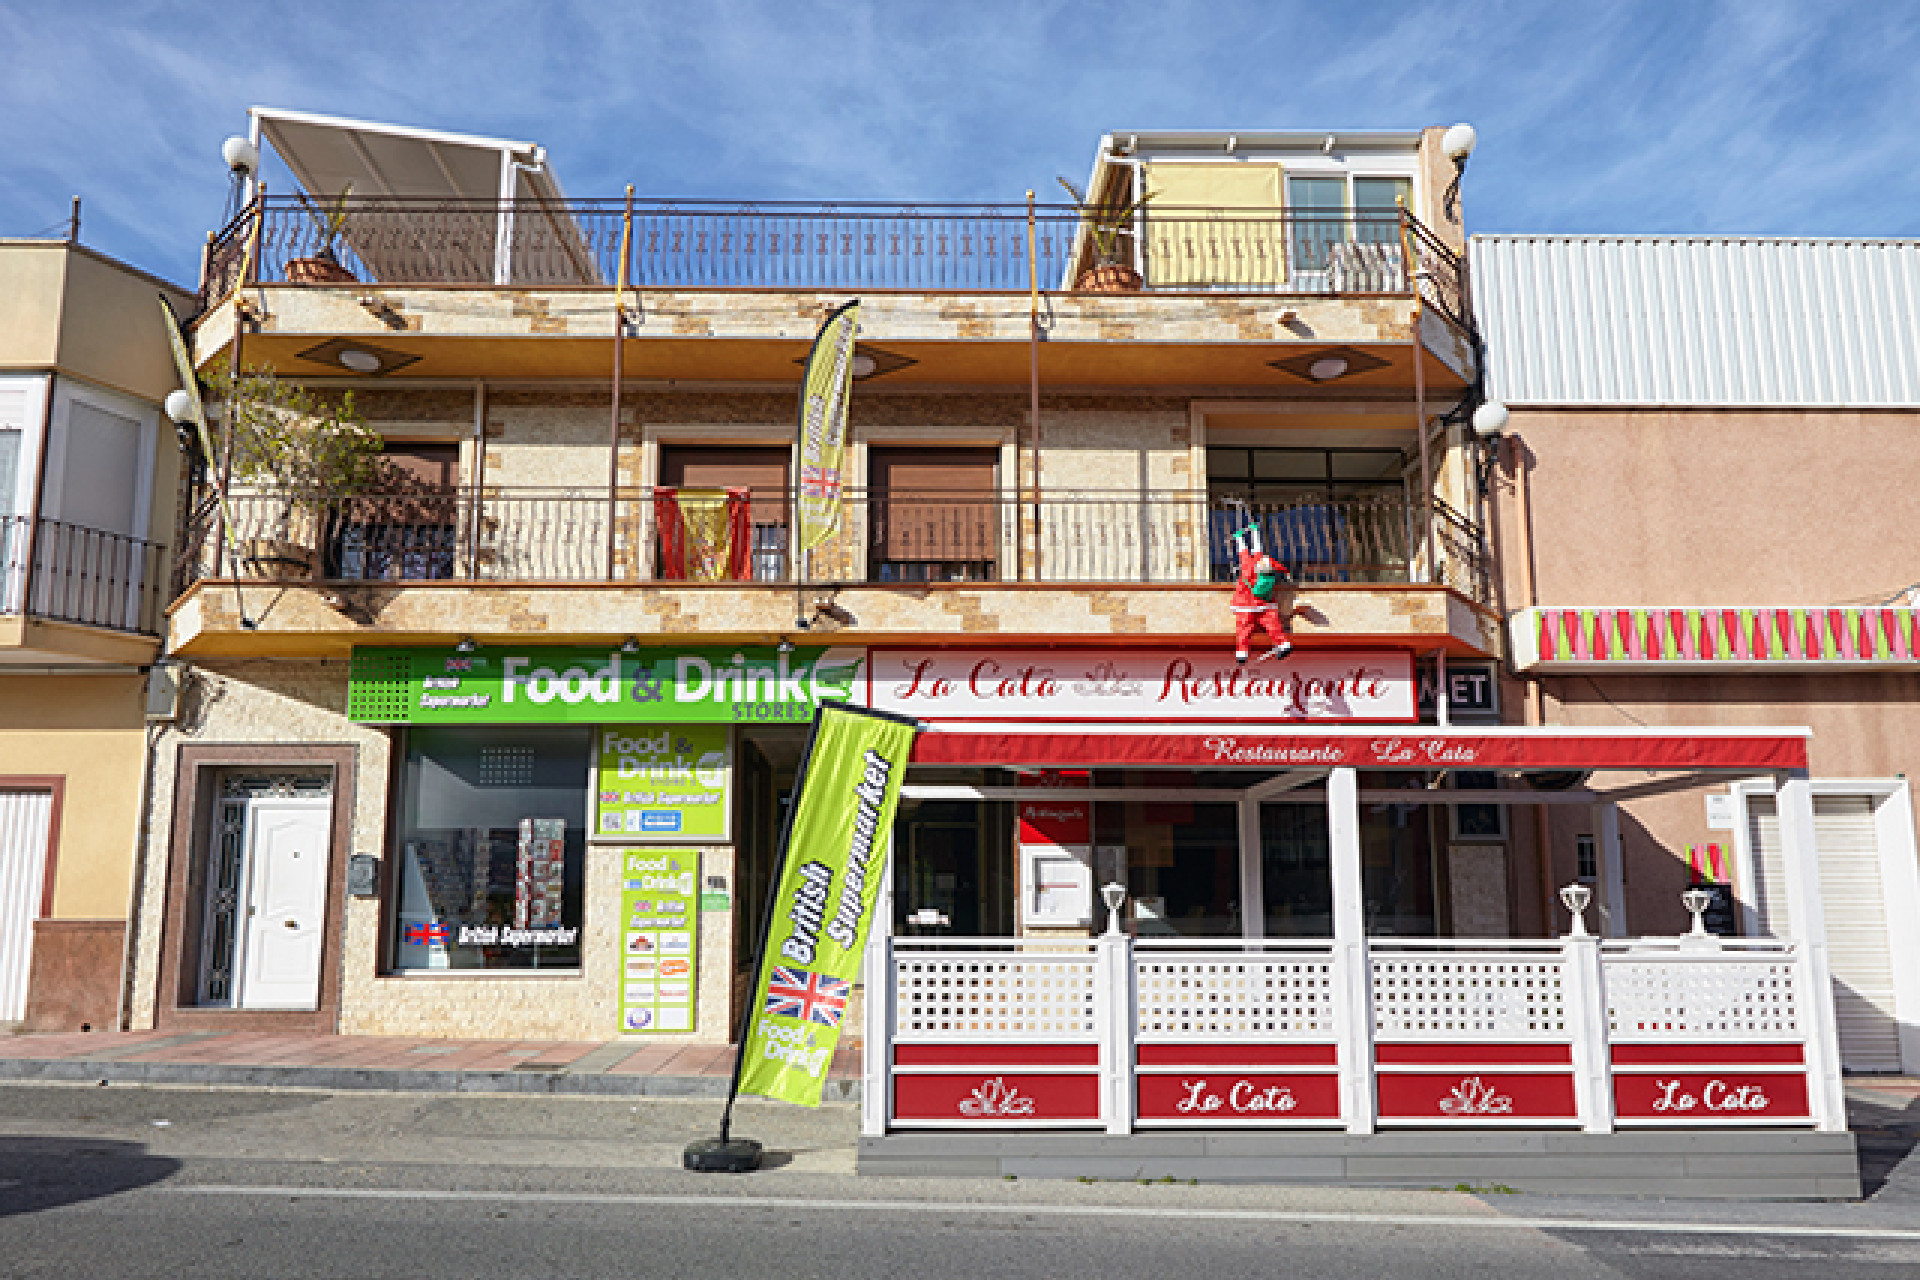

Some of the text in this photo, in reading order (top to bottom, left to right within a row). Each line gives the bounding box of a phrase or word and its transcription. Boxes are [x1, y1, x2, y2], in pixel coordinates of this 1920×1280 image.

[502, 653, 811, 704] Food & Drink
[893, 657, 1393, 704] La Cata Restaurante
[732, 702, 812, 720] STORES
[602, 730, 694, 755] Food &
[1203, 736, 1346, 763] Restaurante
[1371, 738, 1417, 763] La
[617, 754, 695, 779] Drink
[626, 854, 668, 872] Food
[827, 750, 891, 950] Supermarket
[780, 859, 835, 966] British
[757, 1018, 807, 1045] Food
[1176, 1079, 1224, 1112] La
[1651, 1079, 1699, 1111] La
